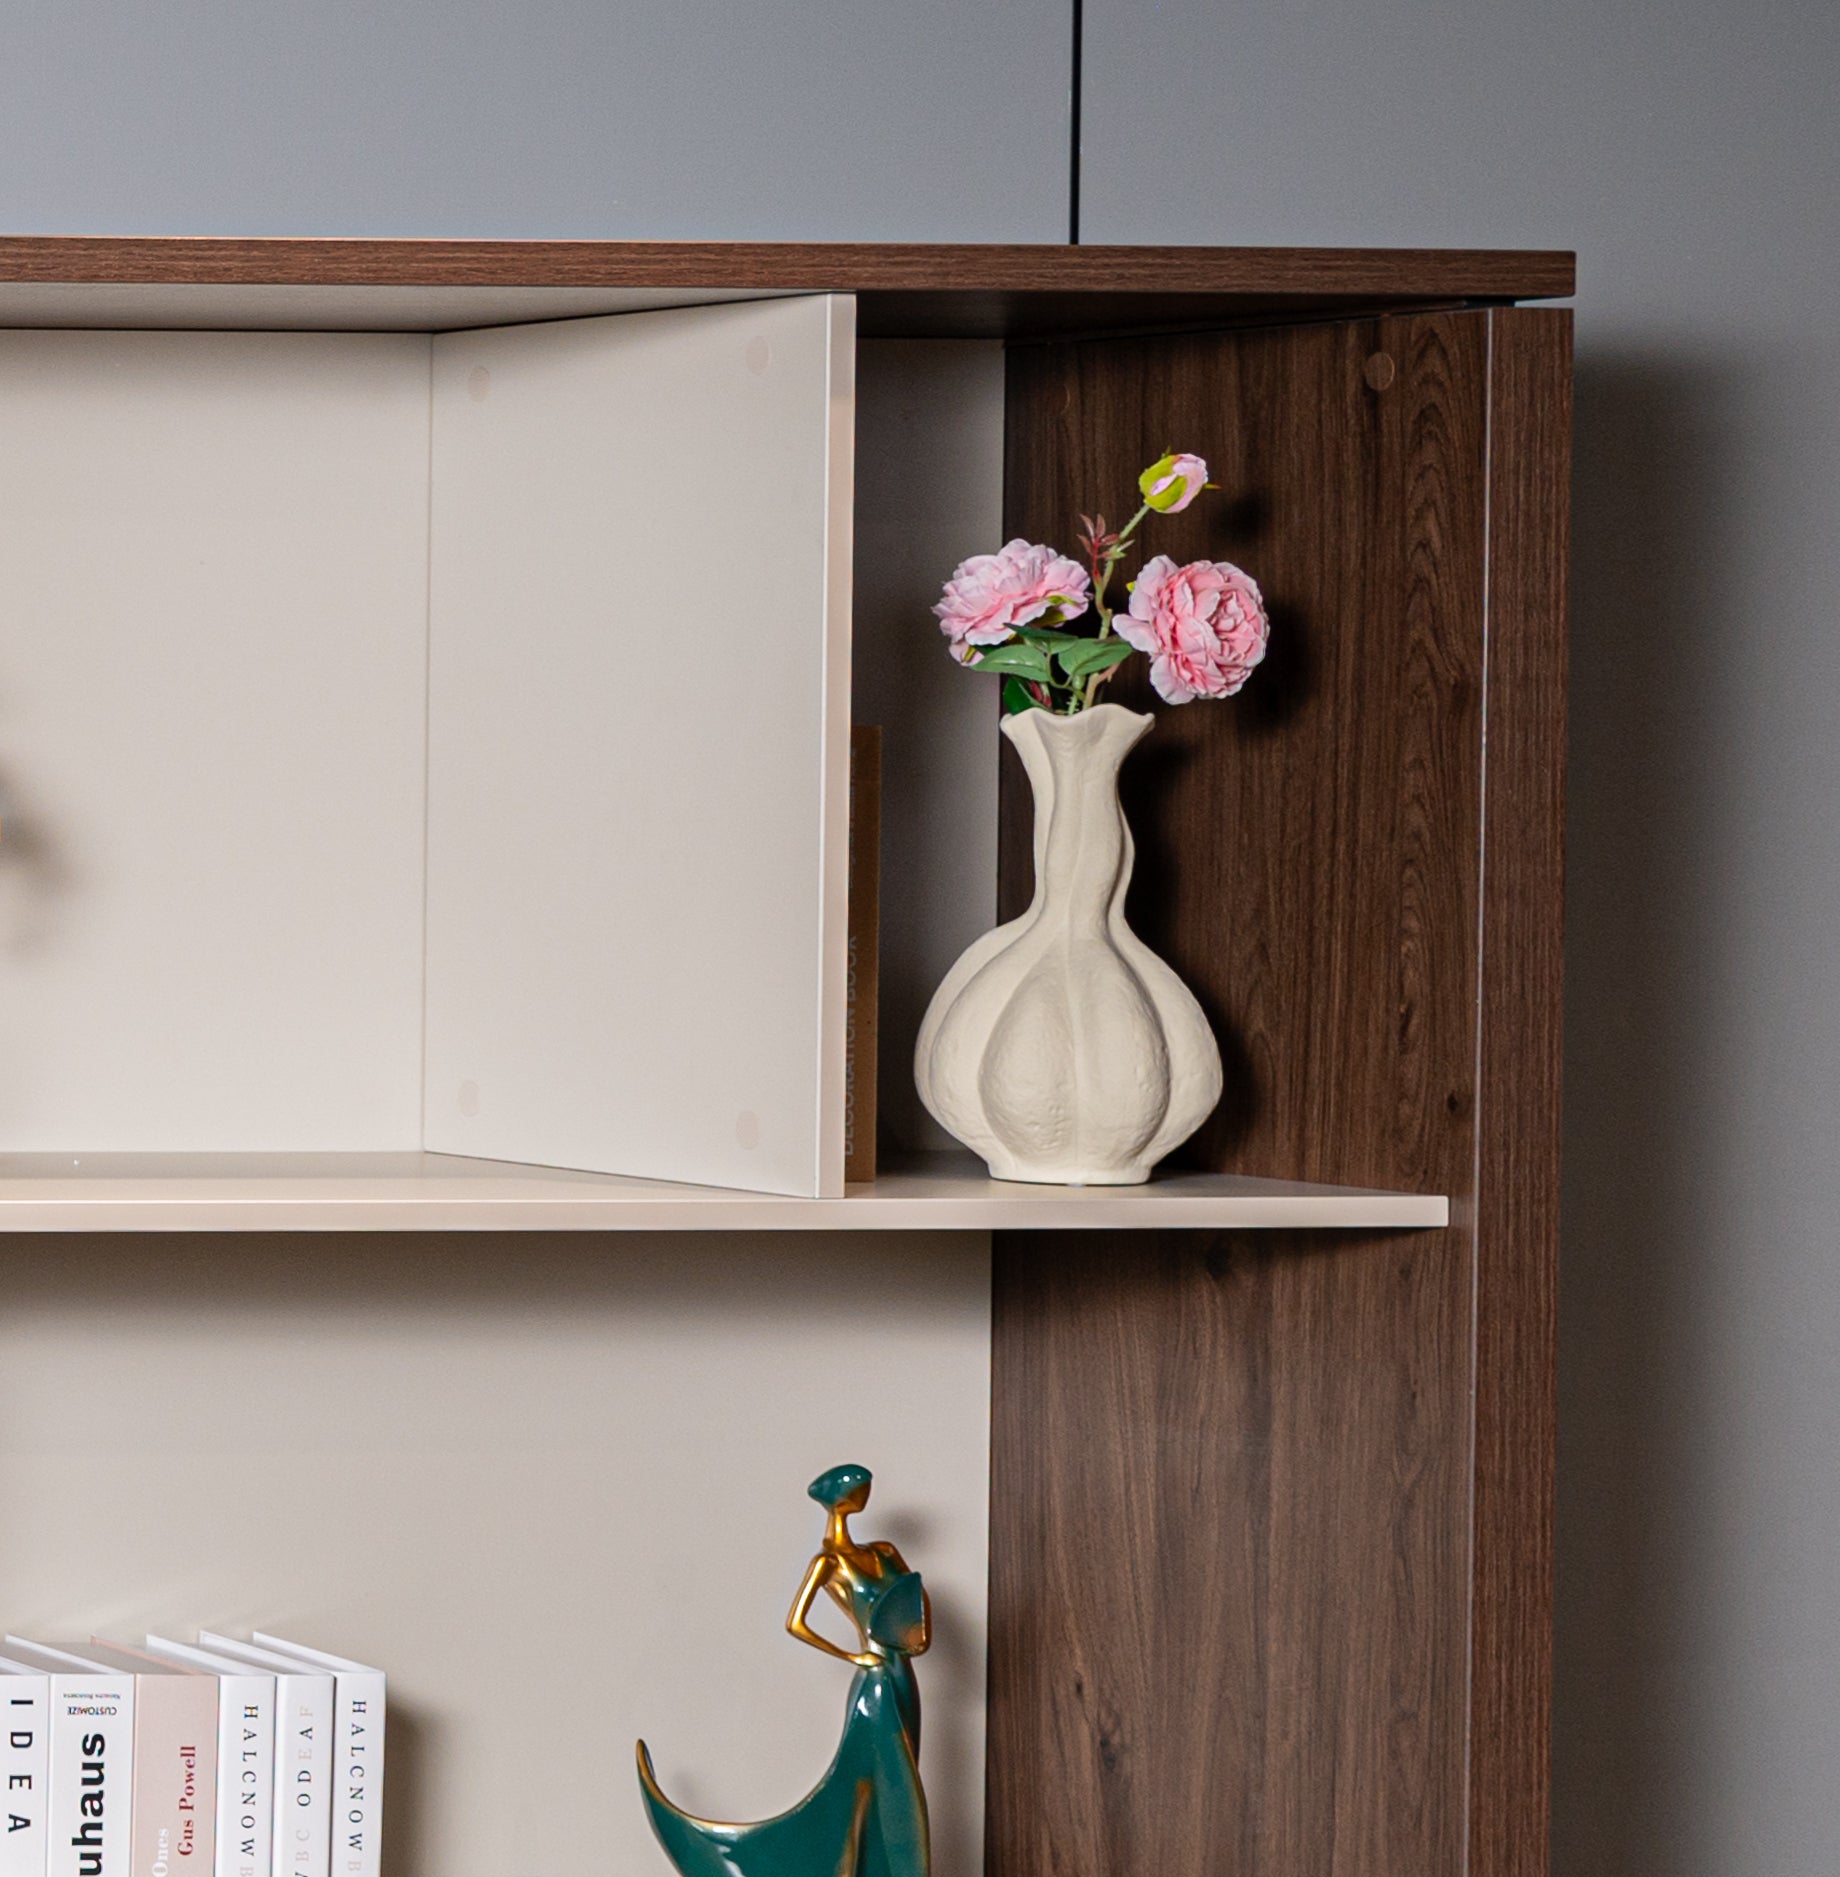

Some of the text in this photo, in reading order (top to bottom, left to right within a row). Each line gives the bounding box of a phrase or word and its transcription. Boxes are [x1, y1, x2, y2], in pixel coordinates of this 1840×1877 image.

[7, 1699, 34, 1833] IDEA
[176, 1745, 197, 1856] Gus Powell
